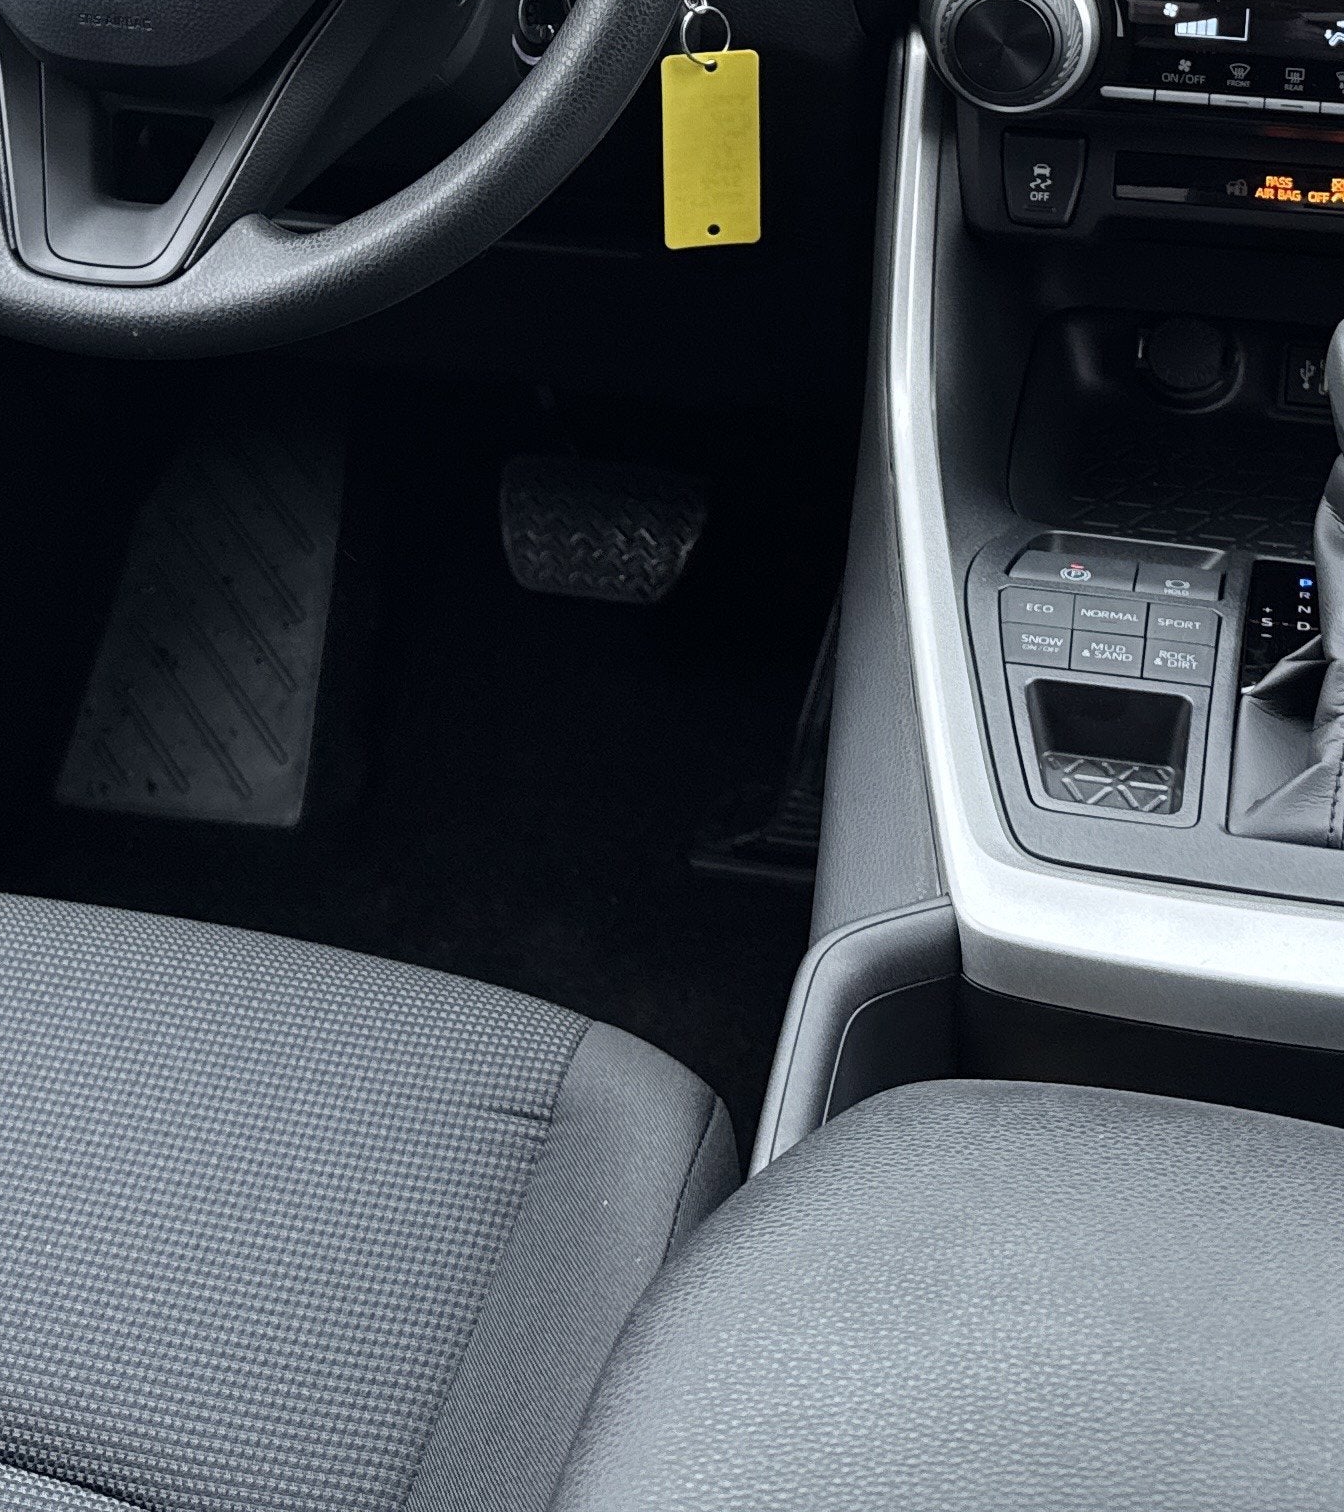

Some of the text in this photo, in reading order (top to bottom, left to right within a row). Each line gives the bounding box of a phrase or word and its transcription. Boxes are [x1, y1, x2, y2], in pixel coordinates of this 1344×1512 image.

[1161, 72, 1206, 85] ON/OFF
[1226, 79, 1251, 88] FRONT
[1284, 83, 1304, 92] REAR
[1265, 176, 1294, 189] PASS
[1029, 191, 1051, 202] OFF
[1255, 187, 1330, 203] AIR BAG OFF
[1299, 591, 1311, 599] R
[1026, 603, 1054, 614] ECO
[1298, 605, 1312, 614] N
[1080, 608, 1139, 623] NORMAL
[1157, 617, 1202, 630] SPORT
[1261, 617, 1273, 627] S
[1297, 621, 1311, 631] D
[1021, 633, 1064, 647] SNOW
[1090, 642, 1127, 654] MUD
[1081, 648, 1133, 663] & SAND
[1159, 649, 1197, 663] ROCK
[1153, 656, 1199, 670] & DIRT
